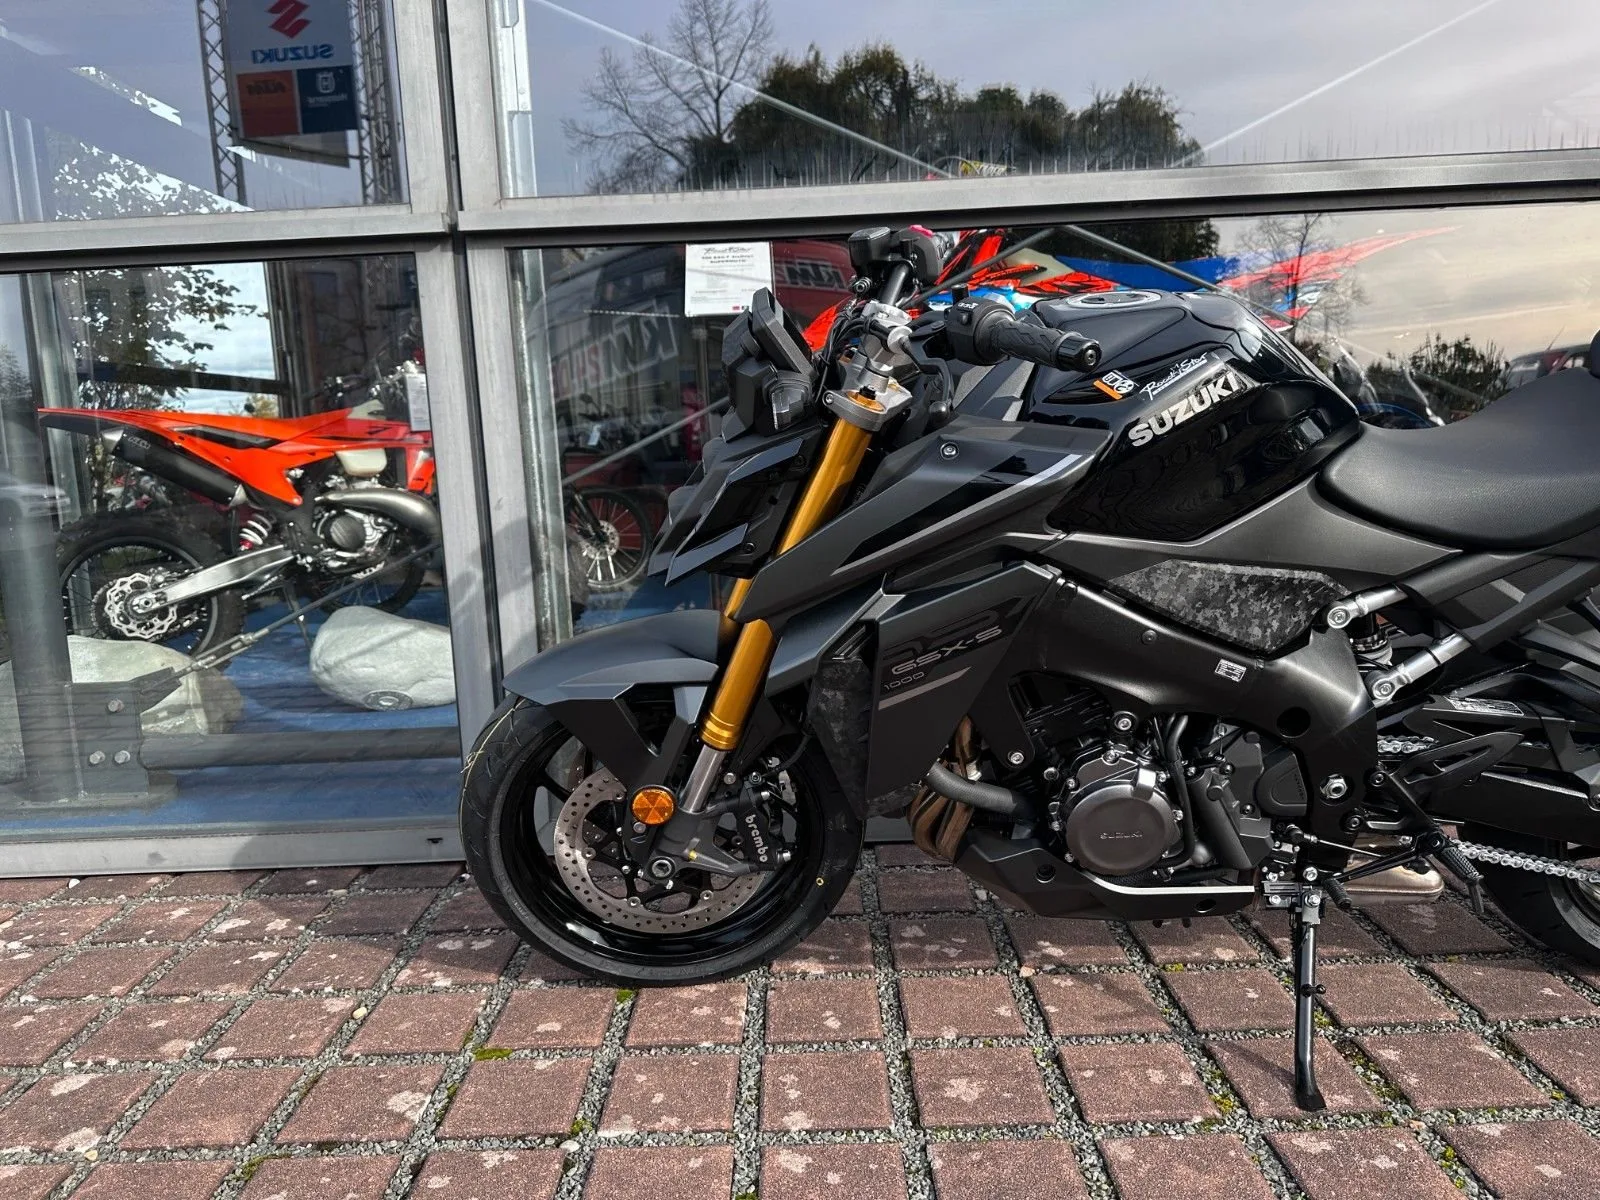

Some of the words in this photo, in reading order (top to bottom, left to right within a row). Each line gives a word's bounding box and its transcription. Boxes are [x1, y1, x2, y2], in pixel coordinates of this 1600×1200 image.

[1128, 371, 1240, 447] SUZUKI
[891, 625, 1002, 676] GSX-S
[884, 671, 925, 691] 1000
[745, 814, 768, 863] brembo
